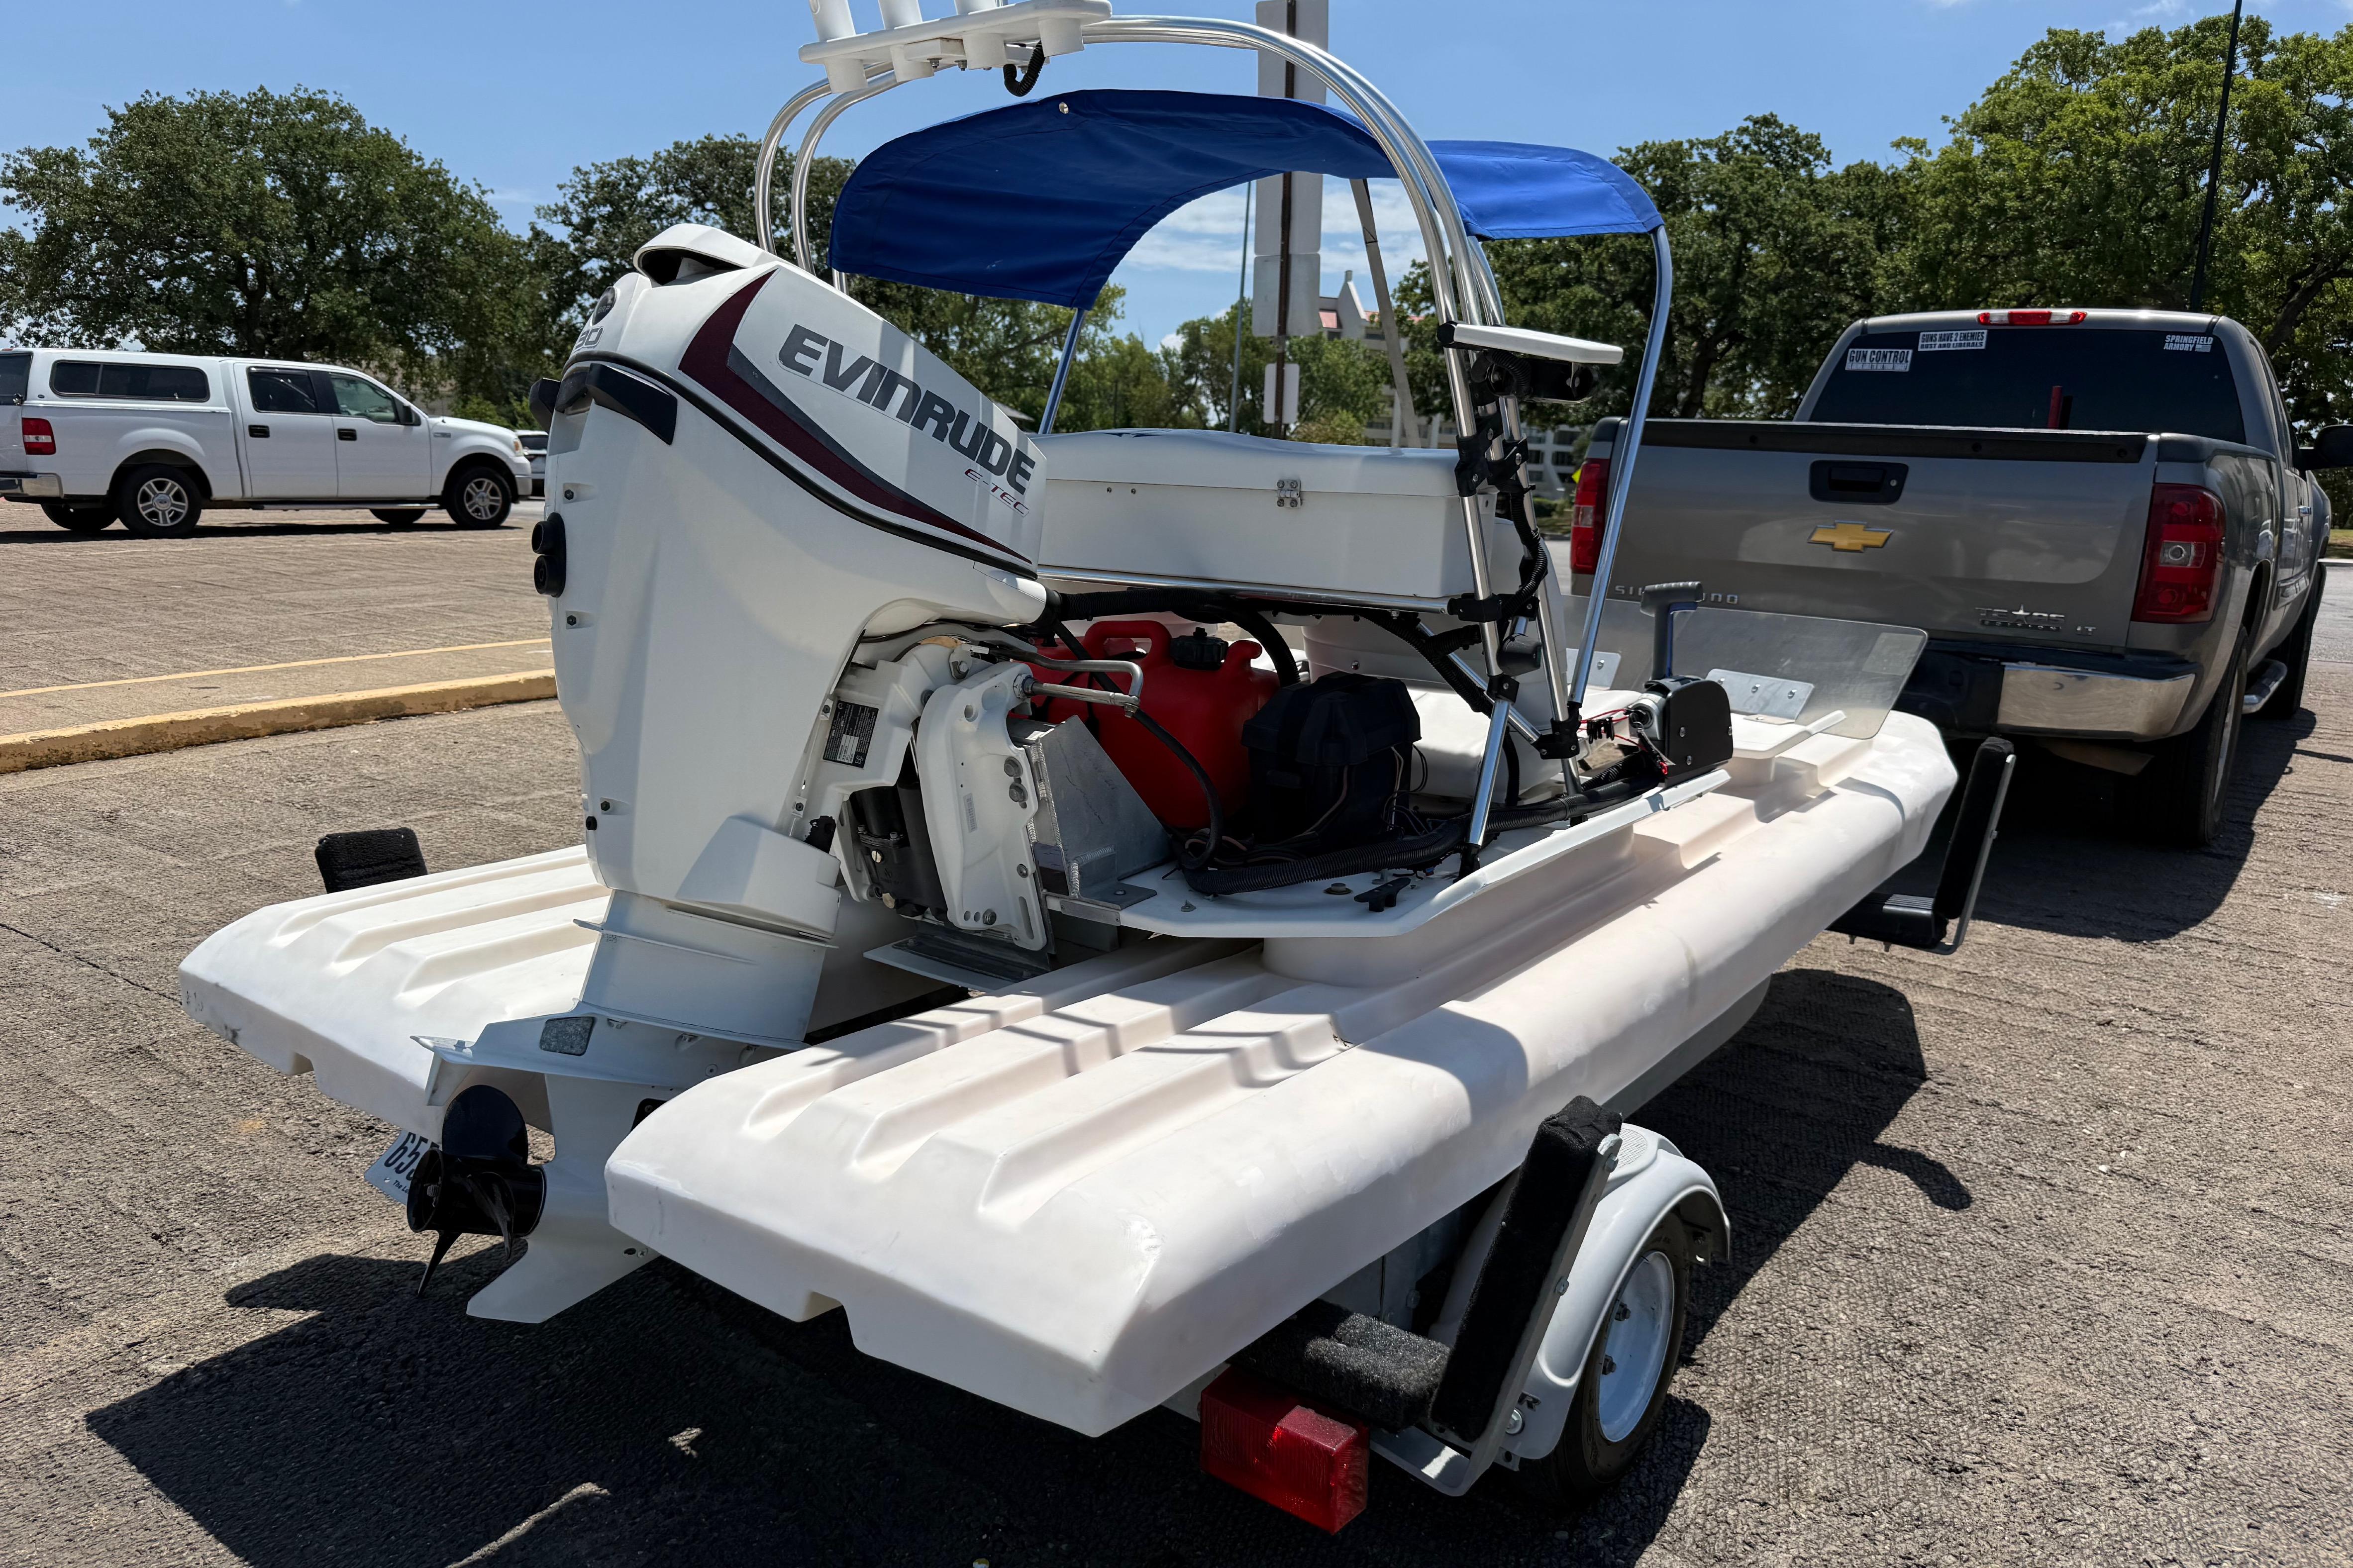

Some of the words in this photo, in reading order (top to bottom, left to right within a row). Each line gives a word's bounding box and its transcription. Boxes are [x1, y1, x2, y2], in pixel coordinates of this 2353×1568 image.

[1921, 333, 1937, 343] GUNS
[1938, 332, 1953, 342] HAVE
[1954, 332, 1959, 342] 2
[1959, 331, 1984, 342] ENEMIES
[2165, 334, 2213, 345] SPRINGFIELD
[2163, 342, 2194, 351] ARMORY
[1849, 350, 1868, 363] GUN
[1869, 350, 1909, 363] CONTROL
[779, 324, 1035, 494] EVINRUDE
[965, 469, 1029, 514] E-TEC
